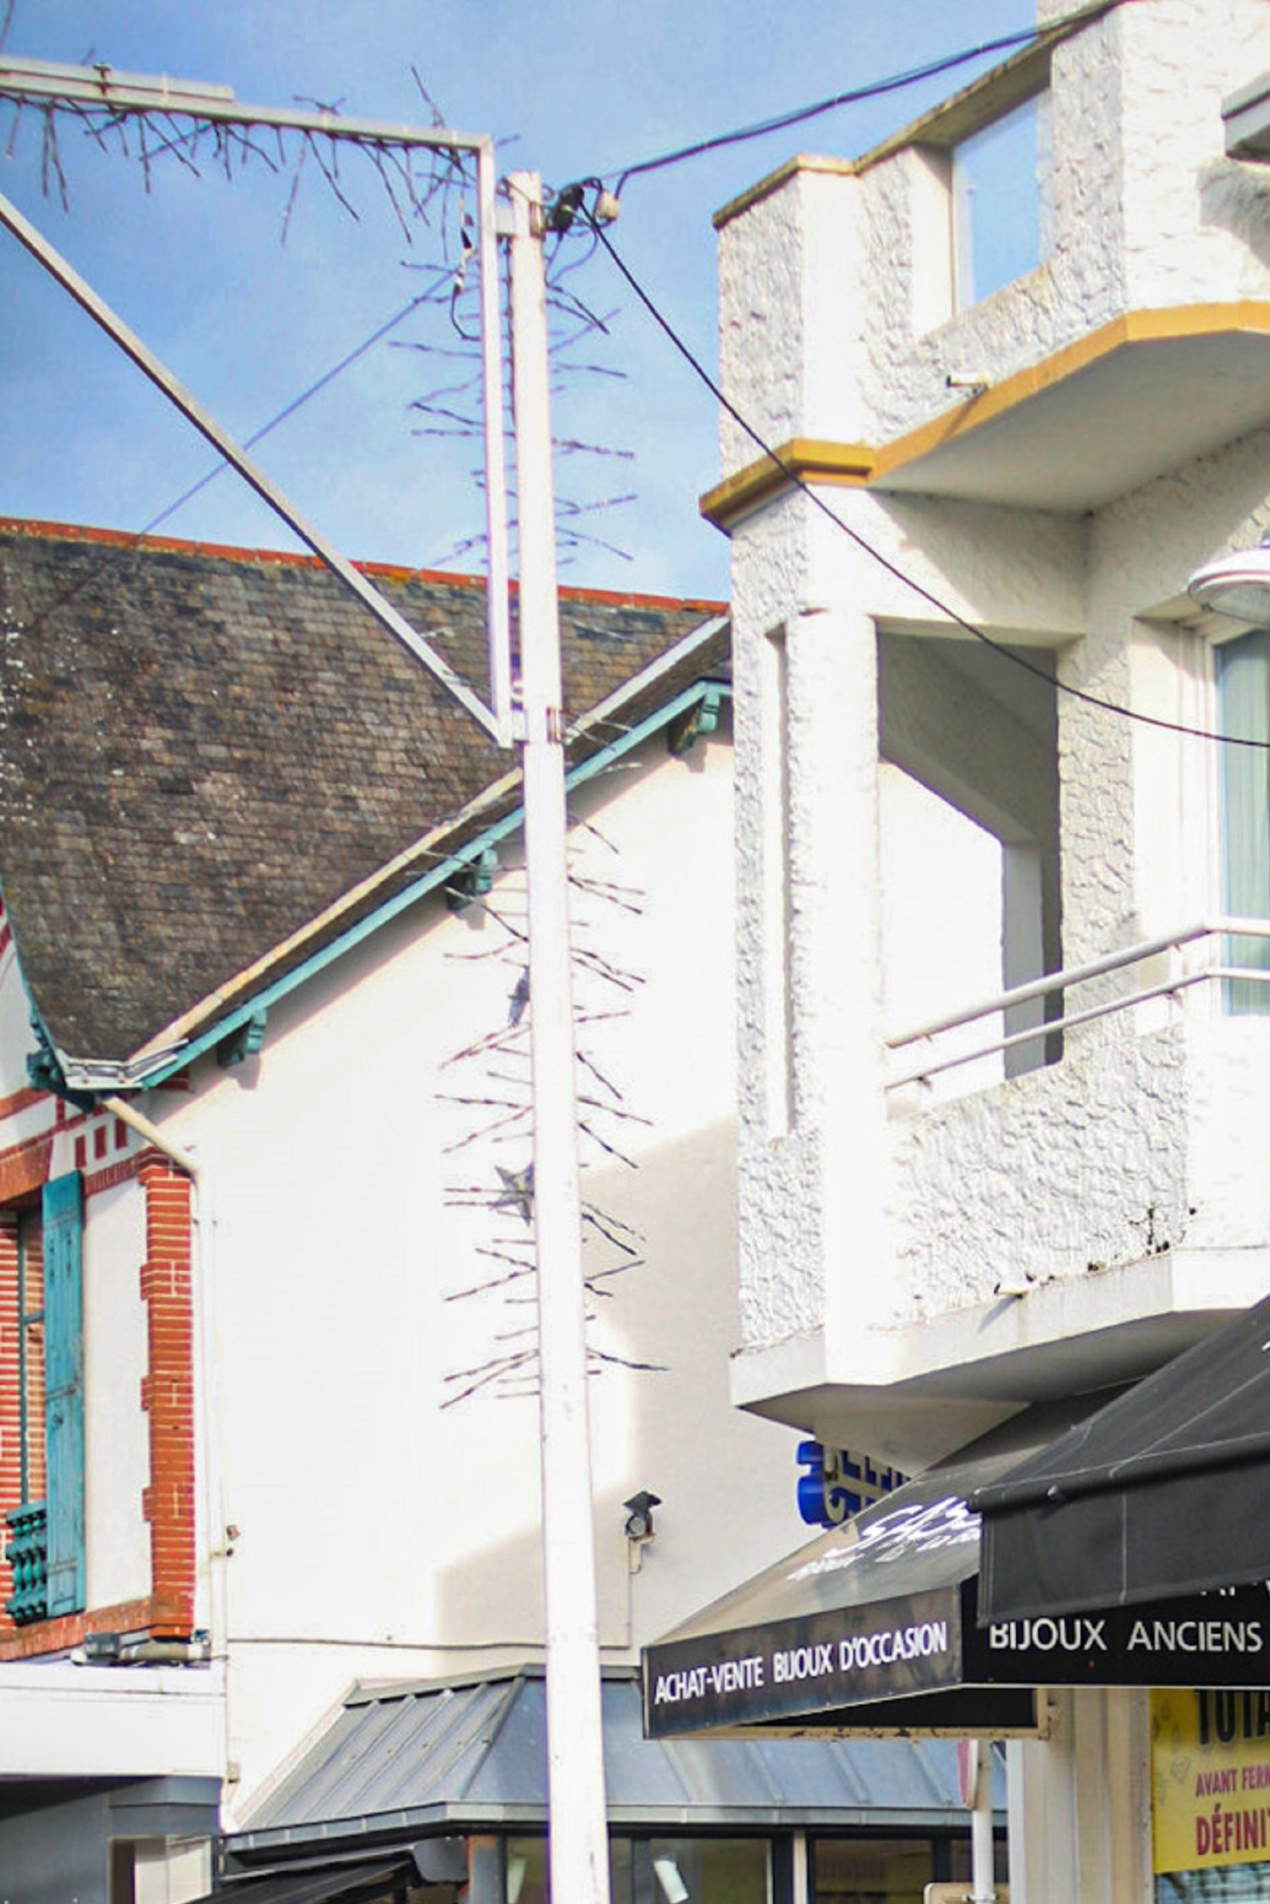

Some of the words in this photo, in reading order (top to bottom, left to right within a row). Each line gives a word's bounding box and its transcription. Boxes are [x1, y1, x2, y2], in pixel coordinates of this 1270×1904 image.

[989, 1617, 1108, 1652] BIJOUX
[1126, 1620, 1264, 1653] ANCIENS
[655, 1656, 764, 1704] ACHAT-VENTE
[772, 1643, 834, 1683] BIJOUX
[839, 1621, 948, 1671] D'OCCASION
[1195, 1768, 1238, 1798] AVANT
